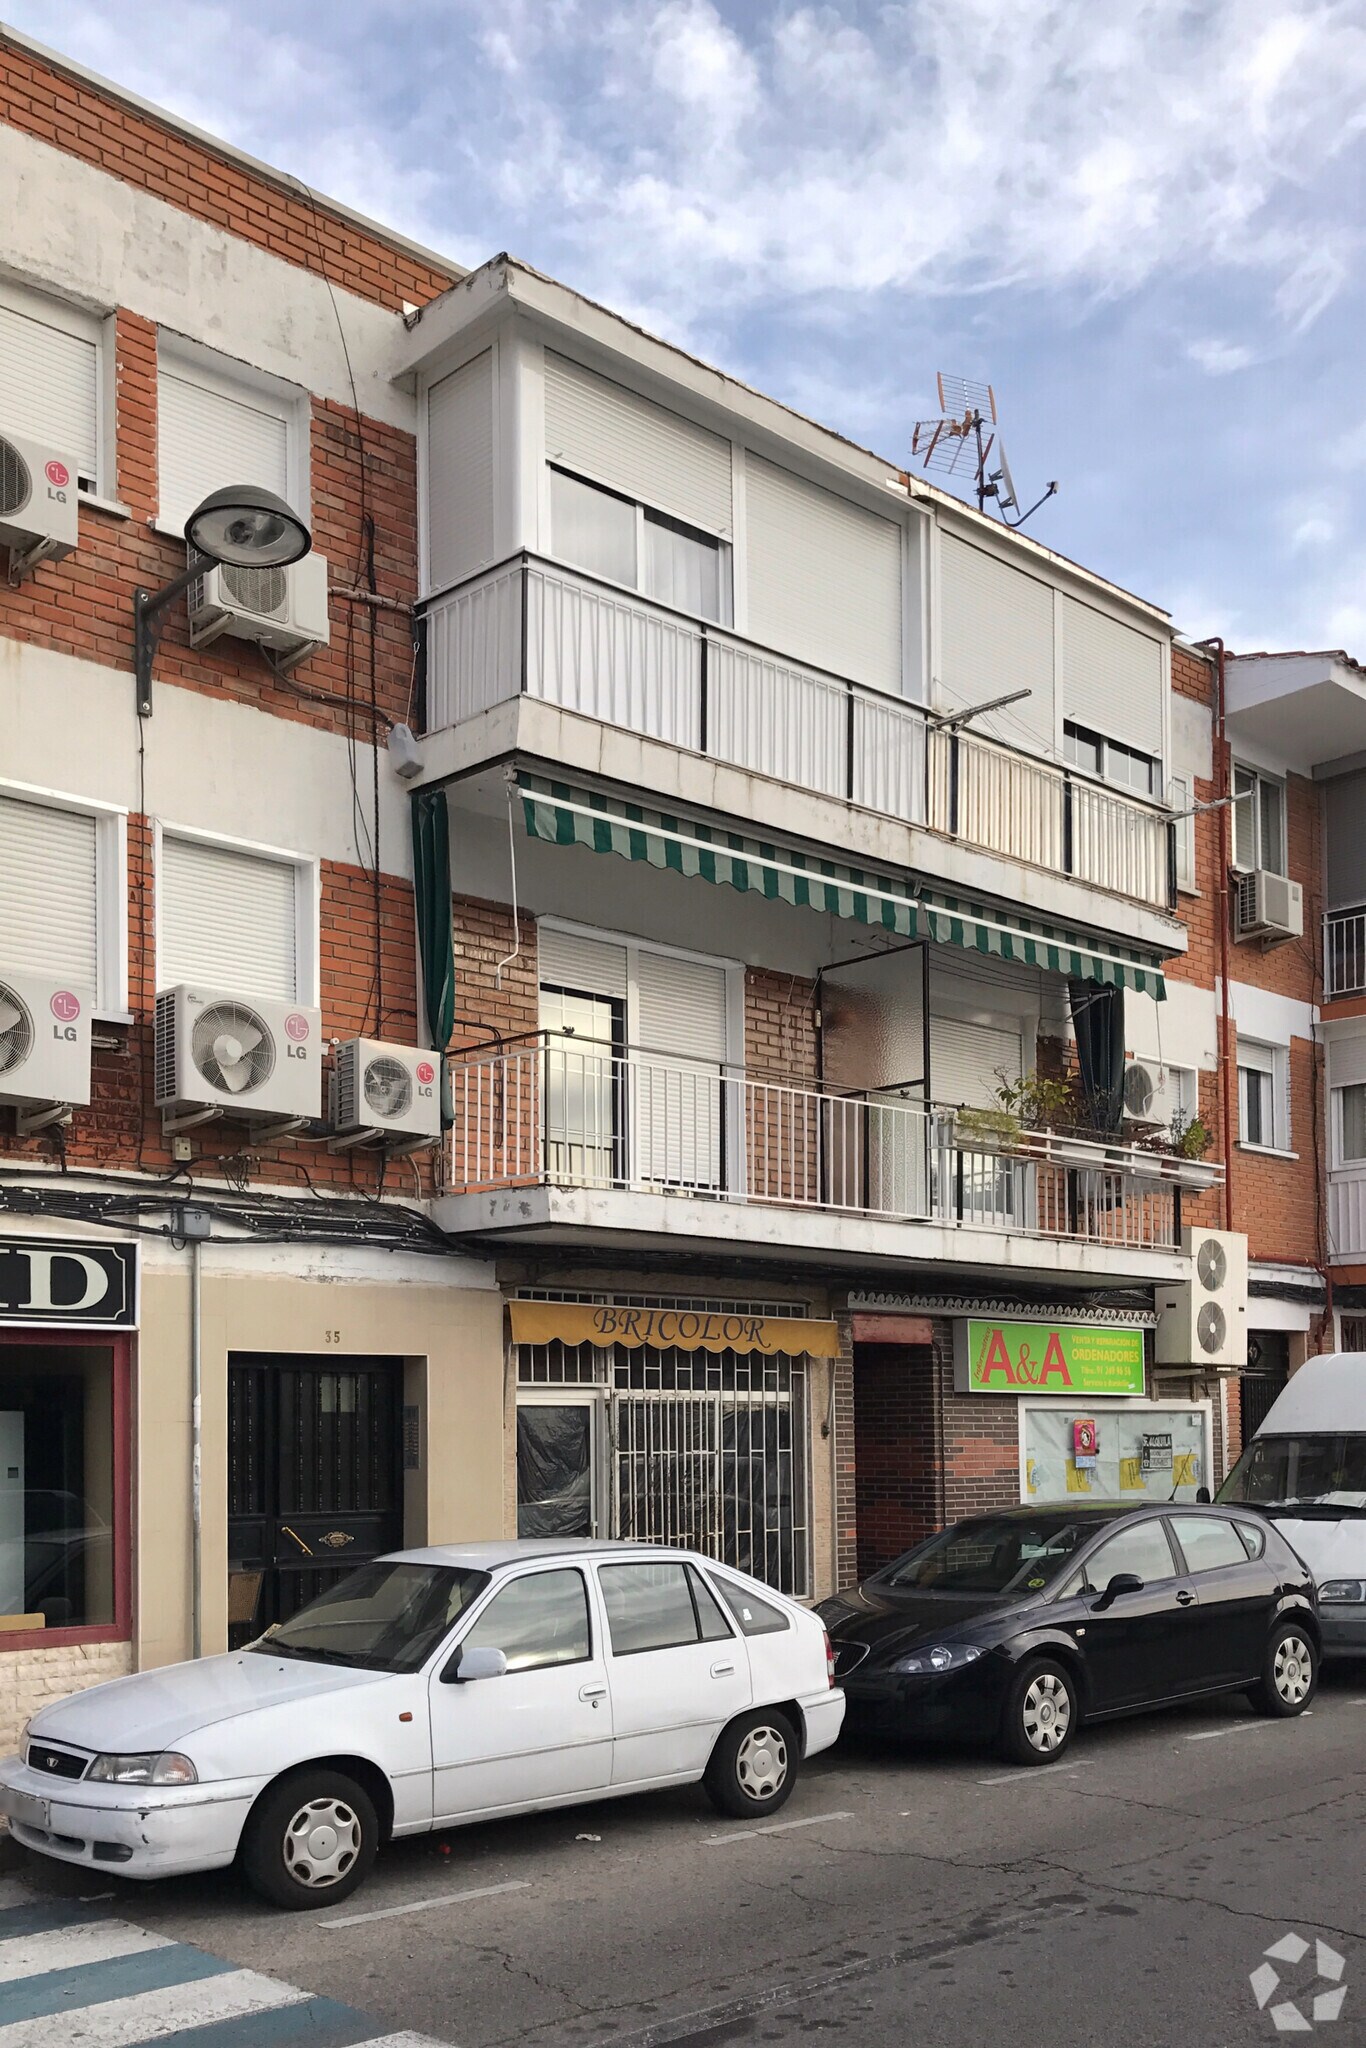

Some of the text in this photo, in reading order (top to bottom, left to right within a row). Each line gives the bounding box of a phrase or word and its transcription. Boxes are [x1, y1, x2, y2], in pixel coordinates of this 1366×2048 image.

[47, 487, 67, 504] LG
[53, 1025, 77, 1043] LG
[286, 1044, 307, 1061] LG
[417, 1085, 433, 1099] LG
[0, 1247, 109, 1311] D
[593, 1306, 772, 1348] BRICOLOR
[325, 1331, 341, 1344] 35
[980, 1328, 1074, 1386] A&A
[1072, 1347, 1139, 1363] ORDENADORES
